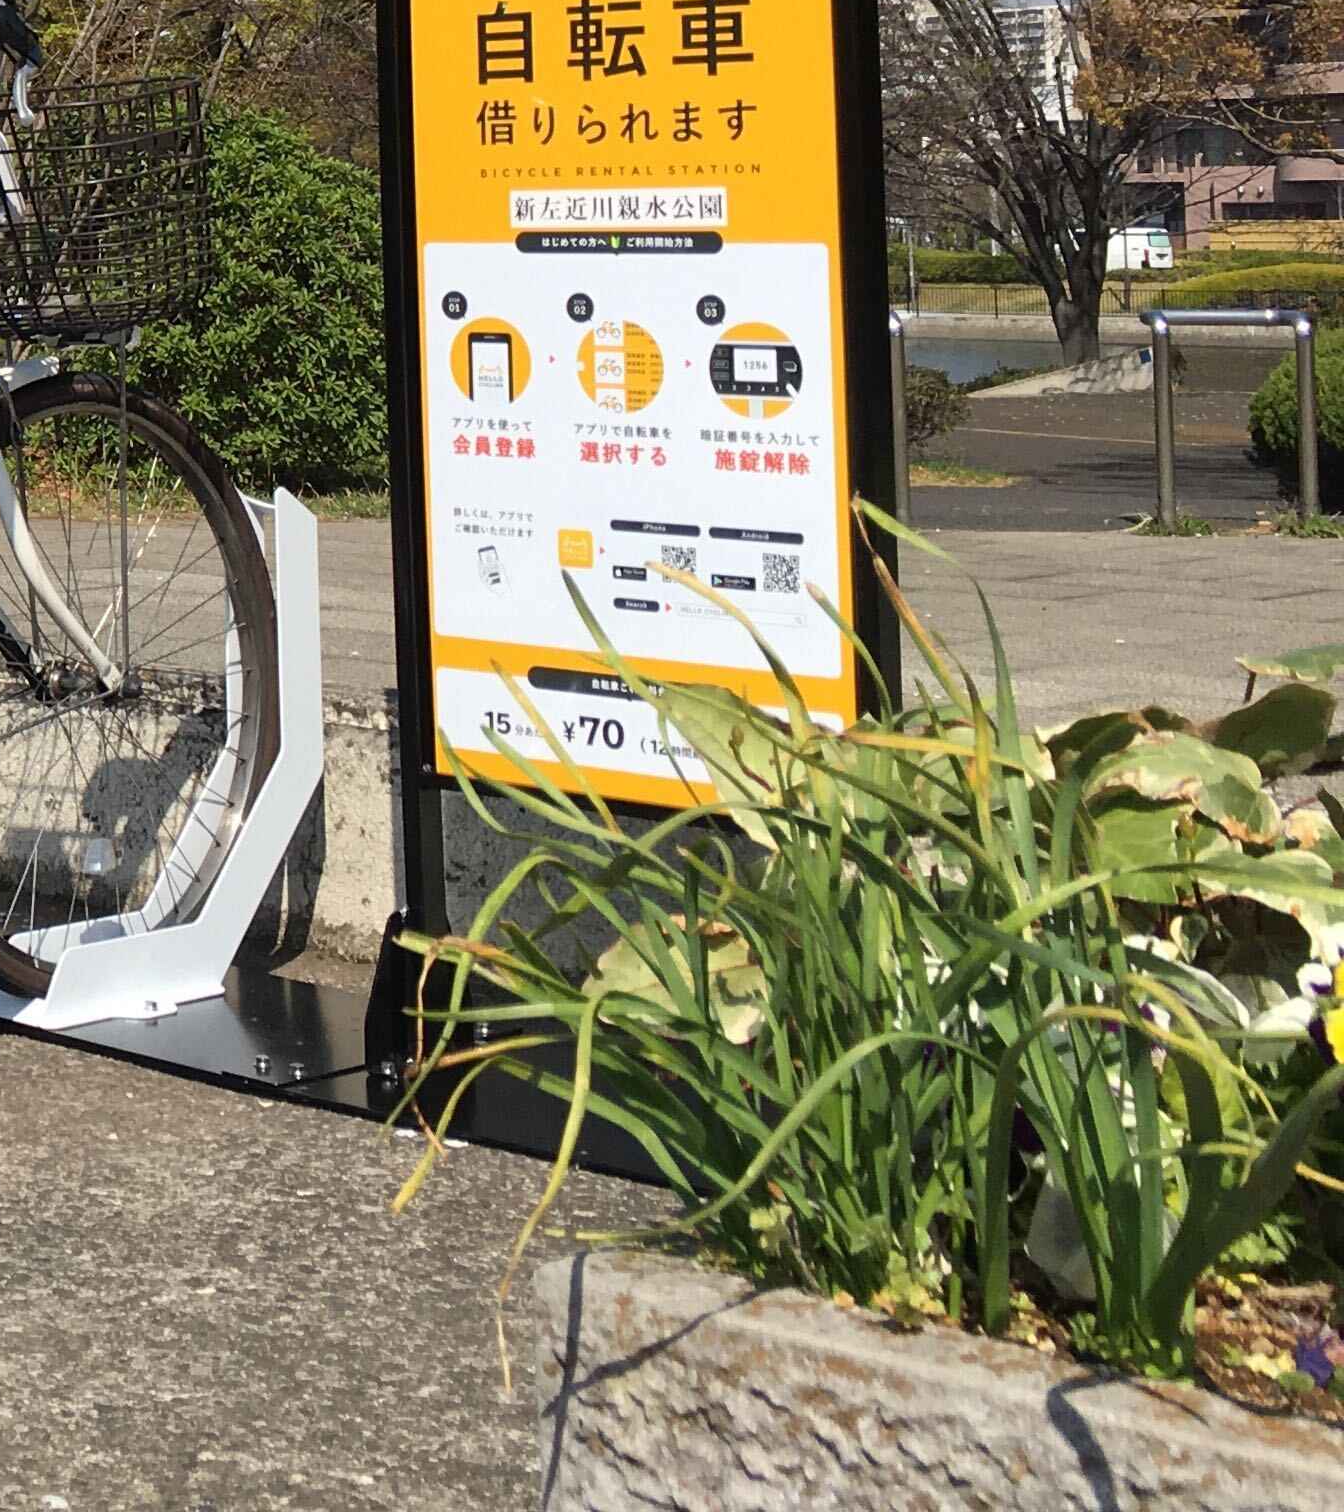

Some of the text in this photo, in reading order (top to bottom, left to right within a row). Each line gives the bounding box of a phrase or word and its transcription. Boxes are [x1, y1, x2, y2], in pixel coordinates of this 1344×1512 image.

[476, 99, 757, 145] 借りられます
[480, 163, 761, 178] BICYCLE RENTAL STATION
[514, 194, 723, 222] 新左近川親水公園
[541, 237, 607, 248] はじめての方へ
[448, 303, 461, 313] 01
[573, 306, 587, 316] 02
[704, 308, 718, 318] 03
[452, 417, 532, 432] アプリを使って
[574, 423, 672, 440] アプリで自転車を
[700, 429, 821, 447] 暗証番号を入力して
[453, 434, 536, 459] 会員登録
[580, 442, 667, 467] 選択する
[714, 449, 811, 477] 施錠解除
[453, 507, 534, 522] 詳しくは、アプリで
[455, 524, 534, 538] ご確認いただけます
[563, 715, 625, 750] ¥70
